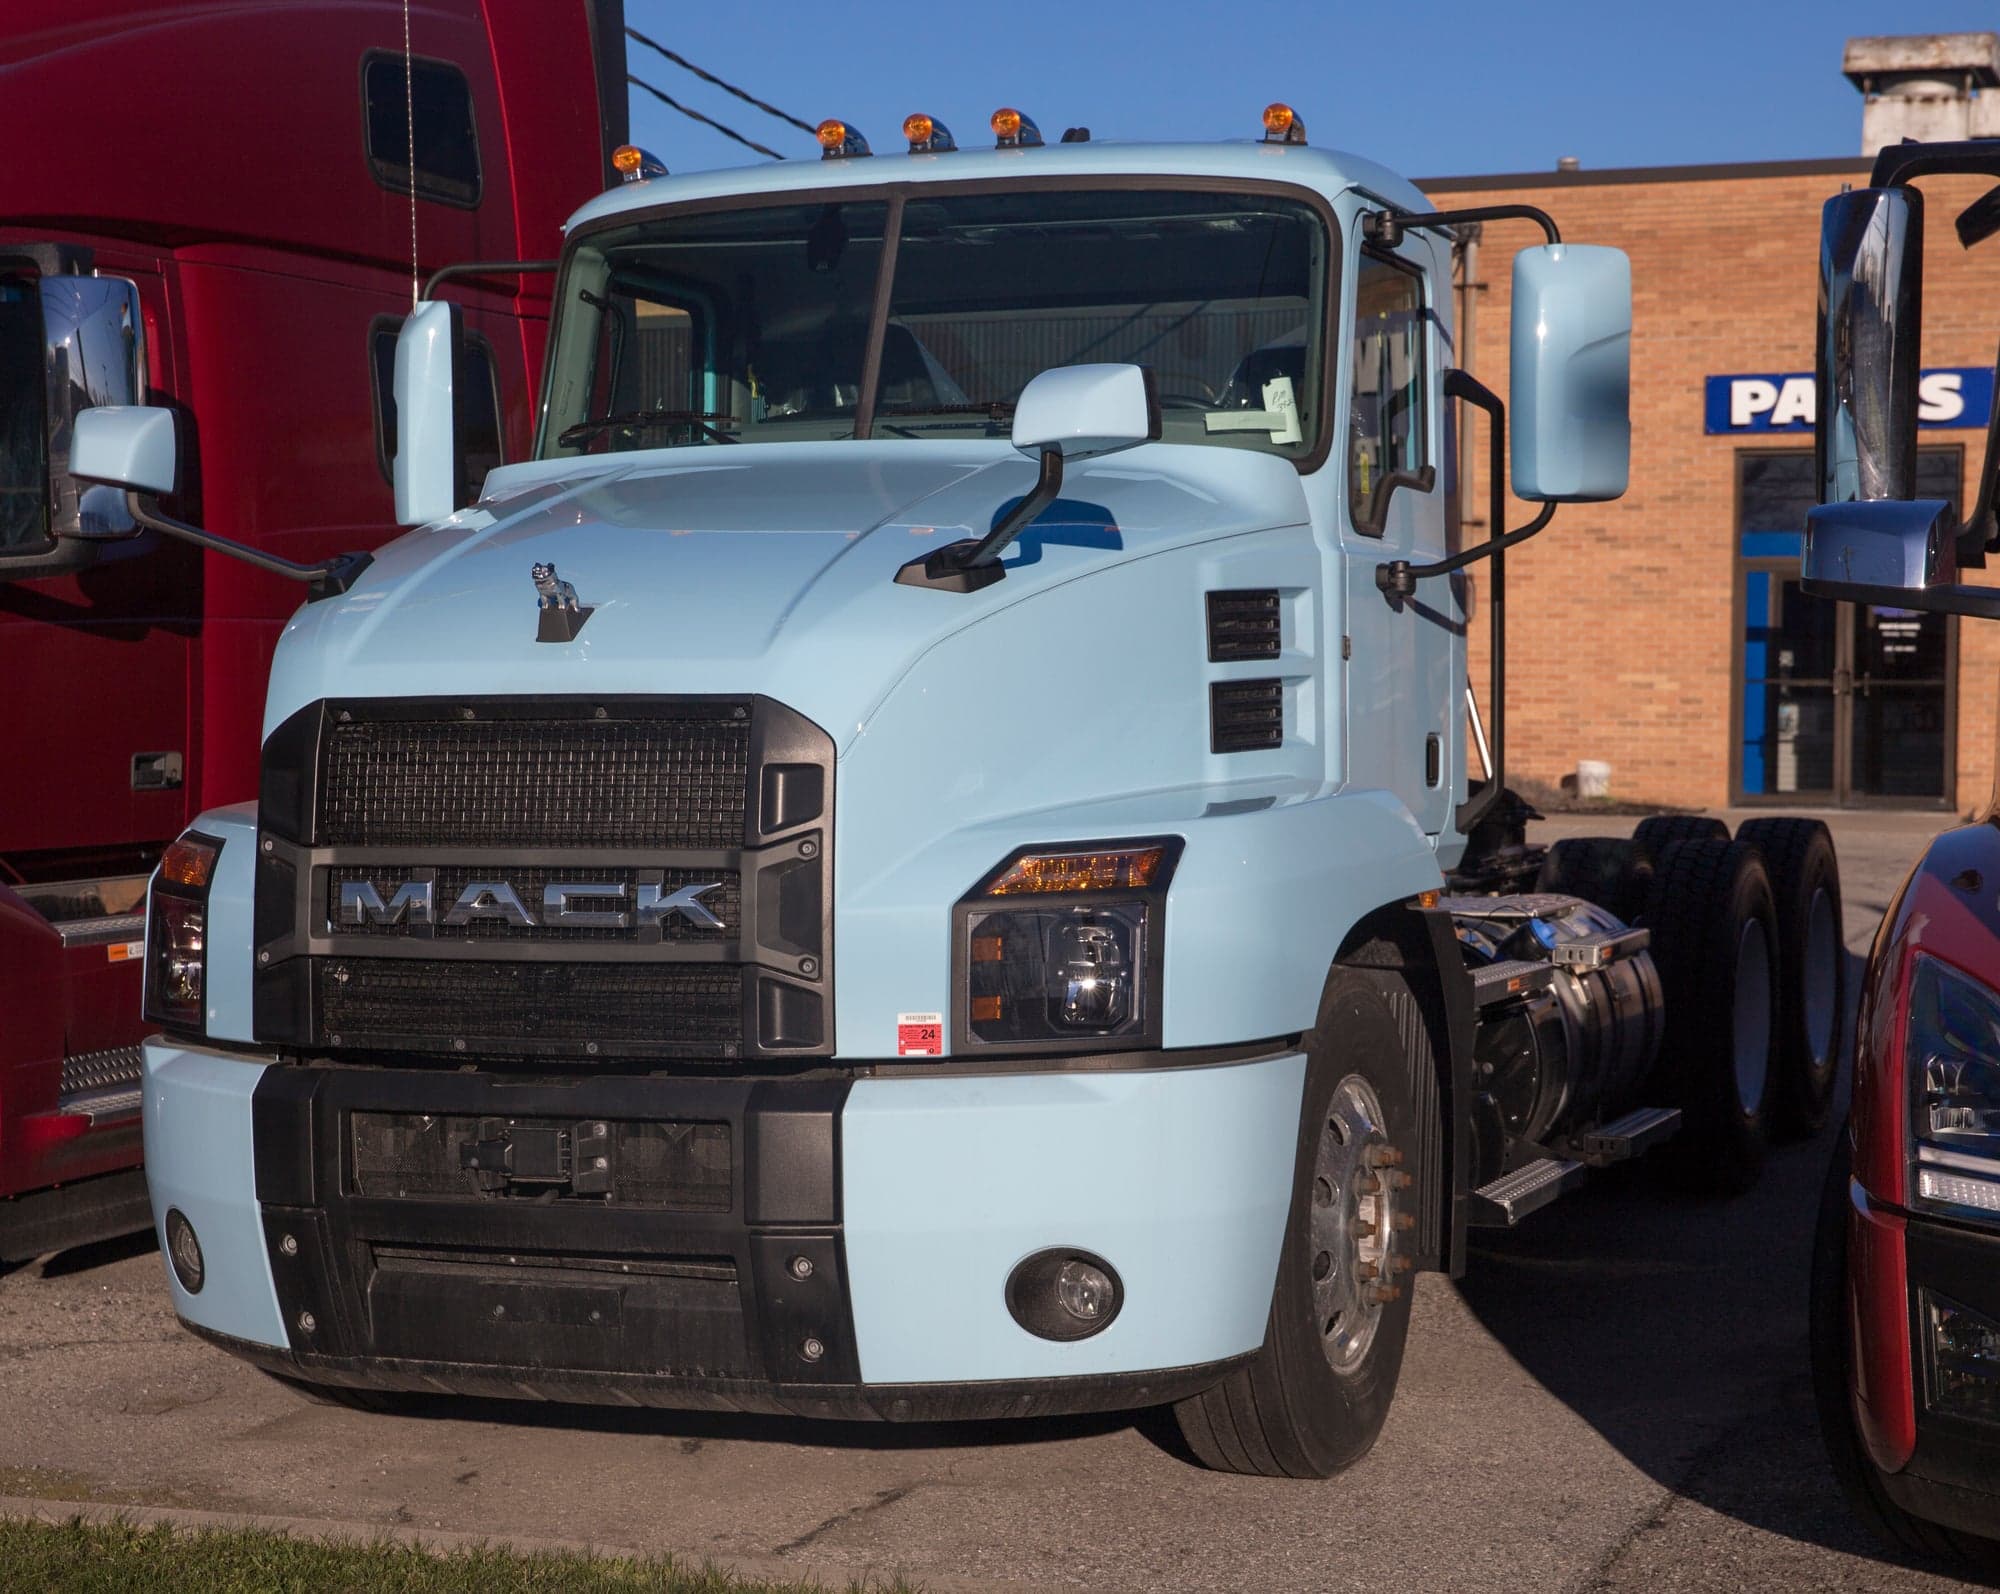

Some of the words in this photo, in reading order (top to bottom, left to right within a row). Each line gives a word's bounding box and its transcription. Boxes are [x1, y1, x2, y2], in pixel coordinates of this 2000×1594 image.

[1730, 374, 1964, 425] PAS
[341, 880, 727, 929] MACK
[921, 1029, 935, 1040] 24
